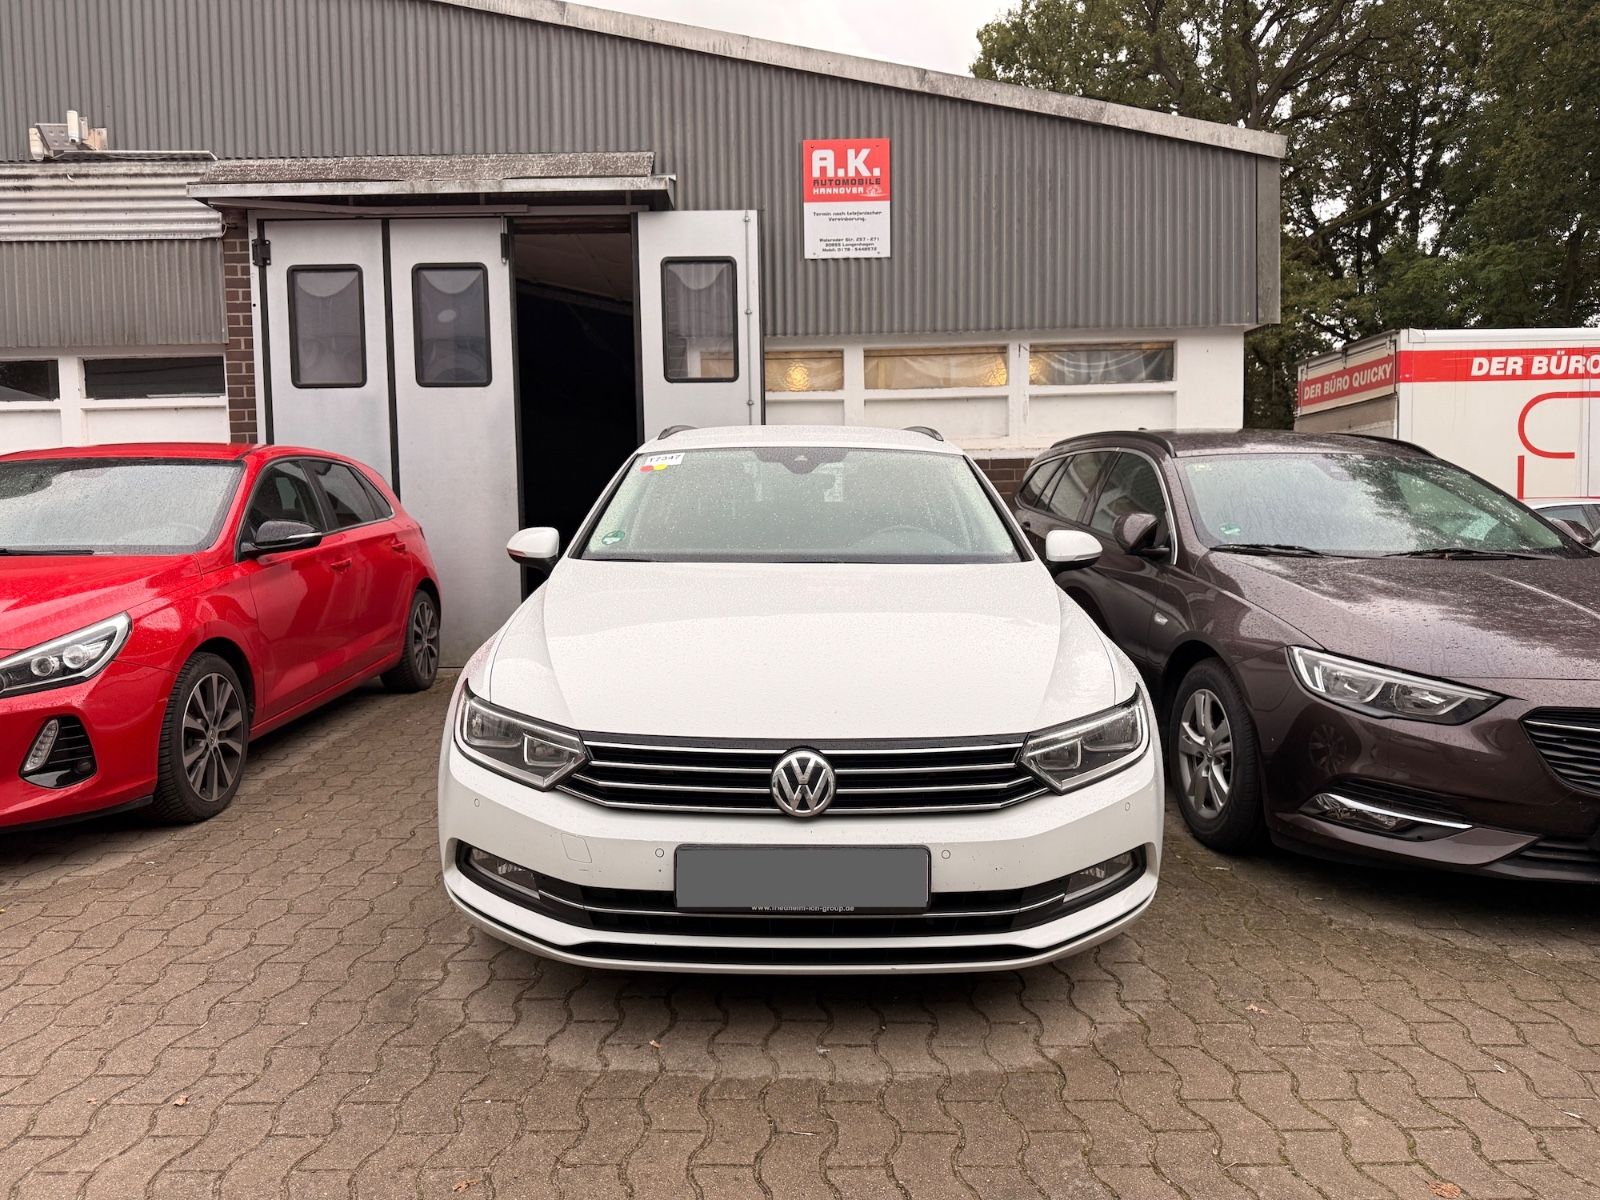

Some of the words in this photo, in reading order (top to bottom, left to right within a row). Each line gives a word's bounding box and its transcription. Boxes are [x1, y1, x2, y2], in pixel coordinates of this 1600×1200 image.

[812, 147, 881, 178] A.K.
[812, 178, 881, 187] AUTOMOBILE
[812, 186, 864, 195] HANNOVER
[1471, 355, 1524, 376] DER
[1531, 350, 1600, 375] BÜRO
[1303, 380, 1322, 400] DER
[1323, 374, 1350, 395] BÜRO
[1352, 362, 1393, 388] QUICKY
